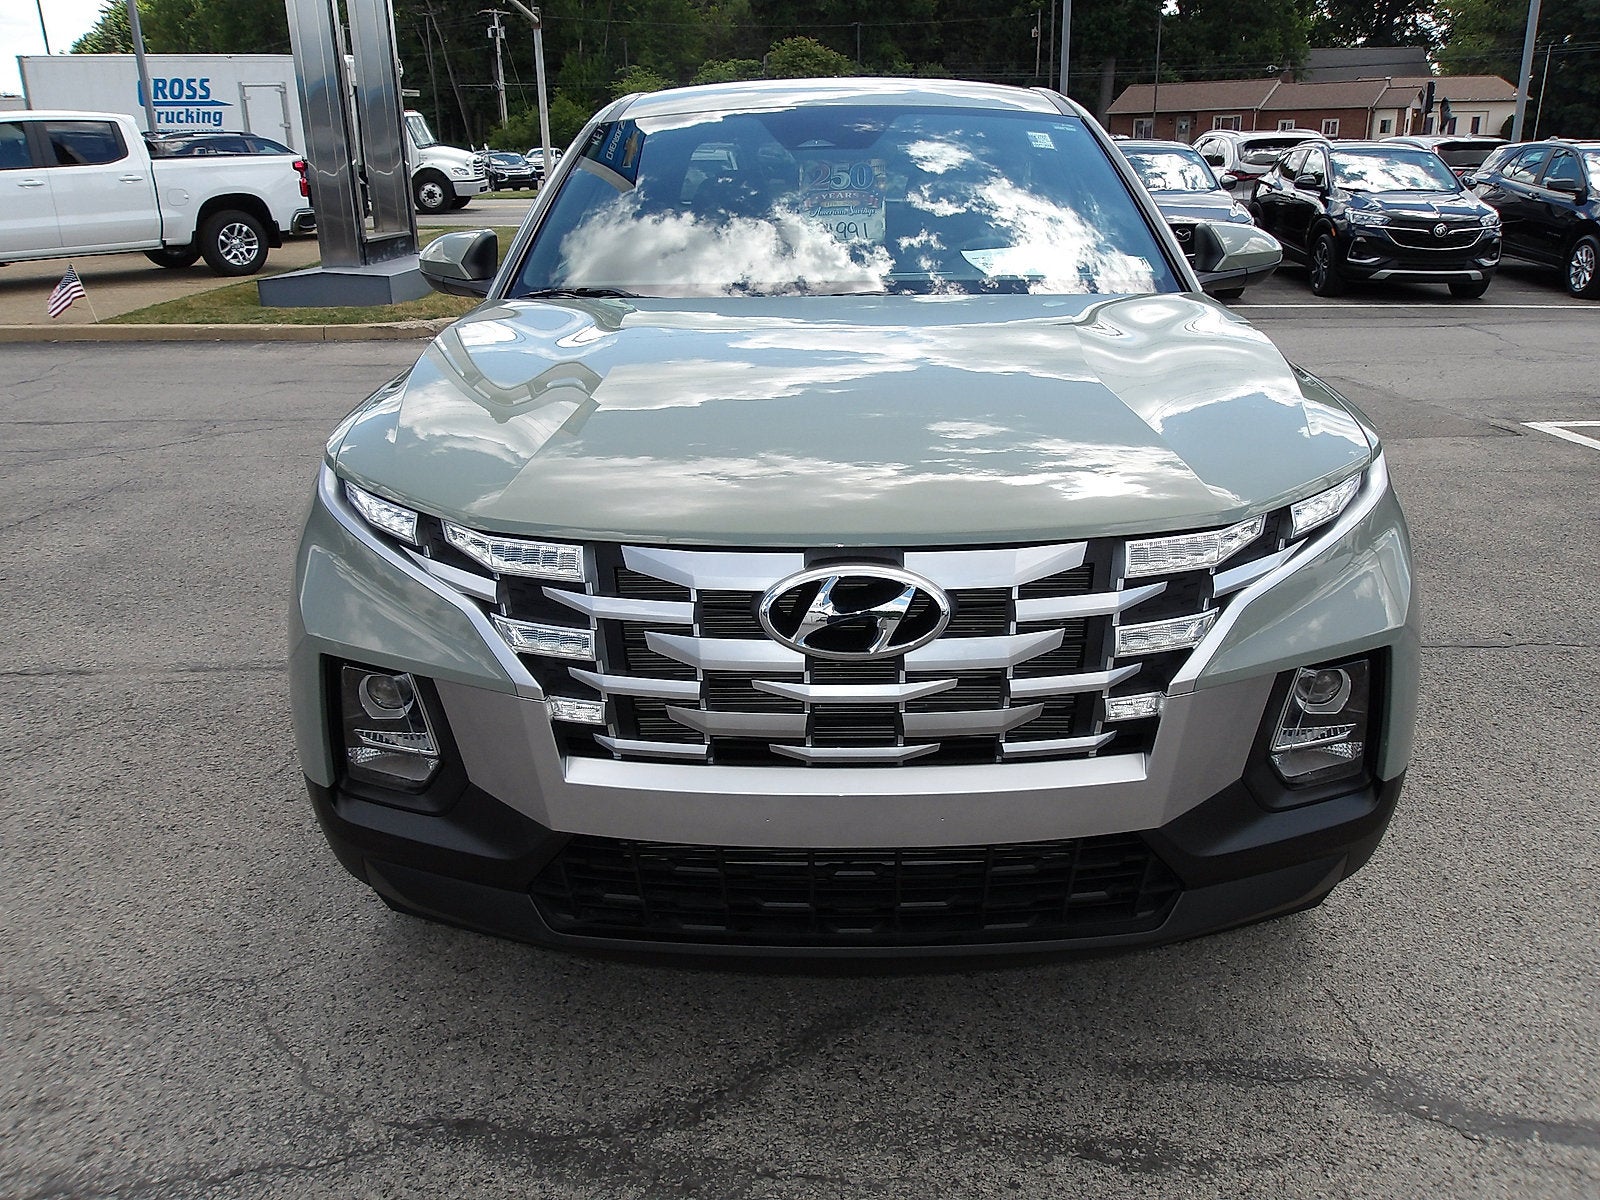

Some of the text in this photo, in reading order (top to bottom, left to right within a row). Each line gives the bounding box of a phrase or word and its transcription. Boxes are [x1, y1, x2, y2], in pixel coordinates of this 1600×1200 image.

[153, 108, 223, 127] rucking
[808, 161, 874, 190] 250
[821, 192, 860, 200] YEARS
